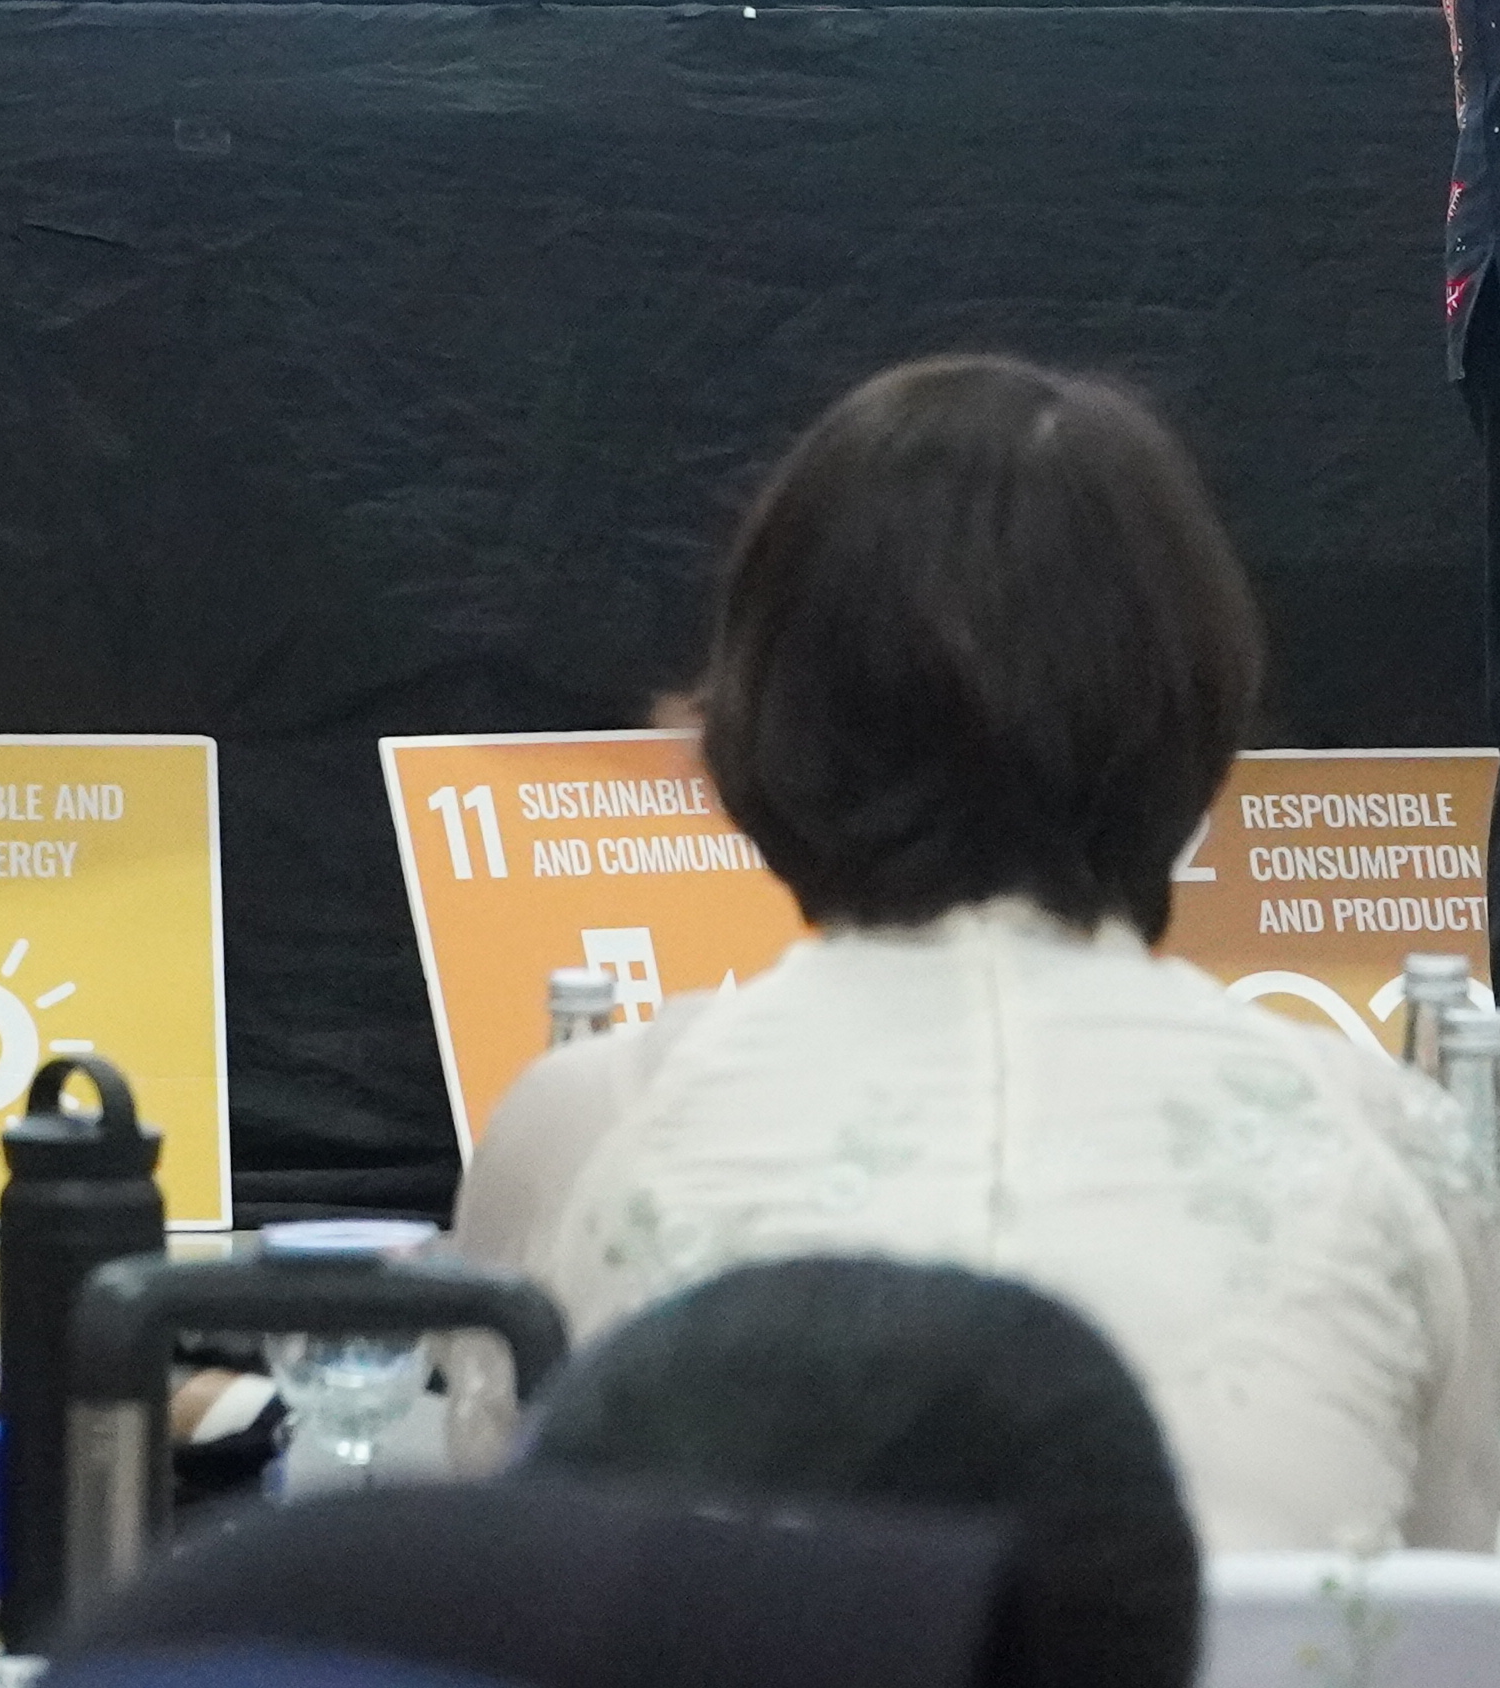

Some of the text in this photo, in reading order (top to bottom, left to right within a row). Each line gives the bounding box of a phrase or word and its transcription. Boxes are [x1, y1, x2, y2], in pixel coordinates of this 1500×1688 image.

[54, 784, 124, 820] AND
[1240, 793, 1457, 829] RESPONSIBLE
[428, 778, 711, 880] 11 SUSTAINABLE
[534, 839, 591, 878] AND
[1250, 845, 1482, 881] CONSUMPTION
[1259, 899, 1324, 934] AND
